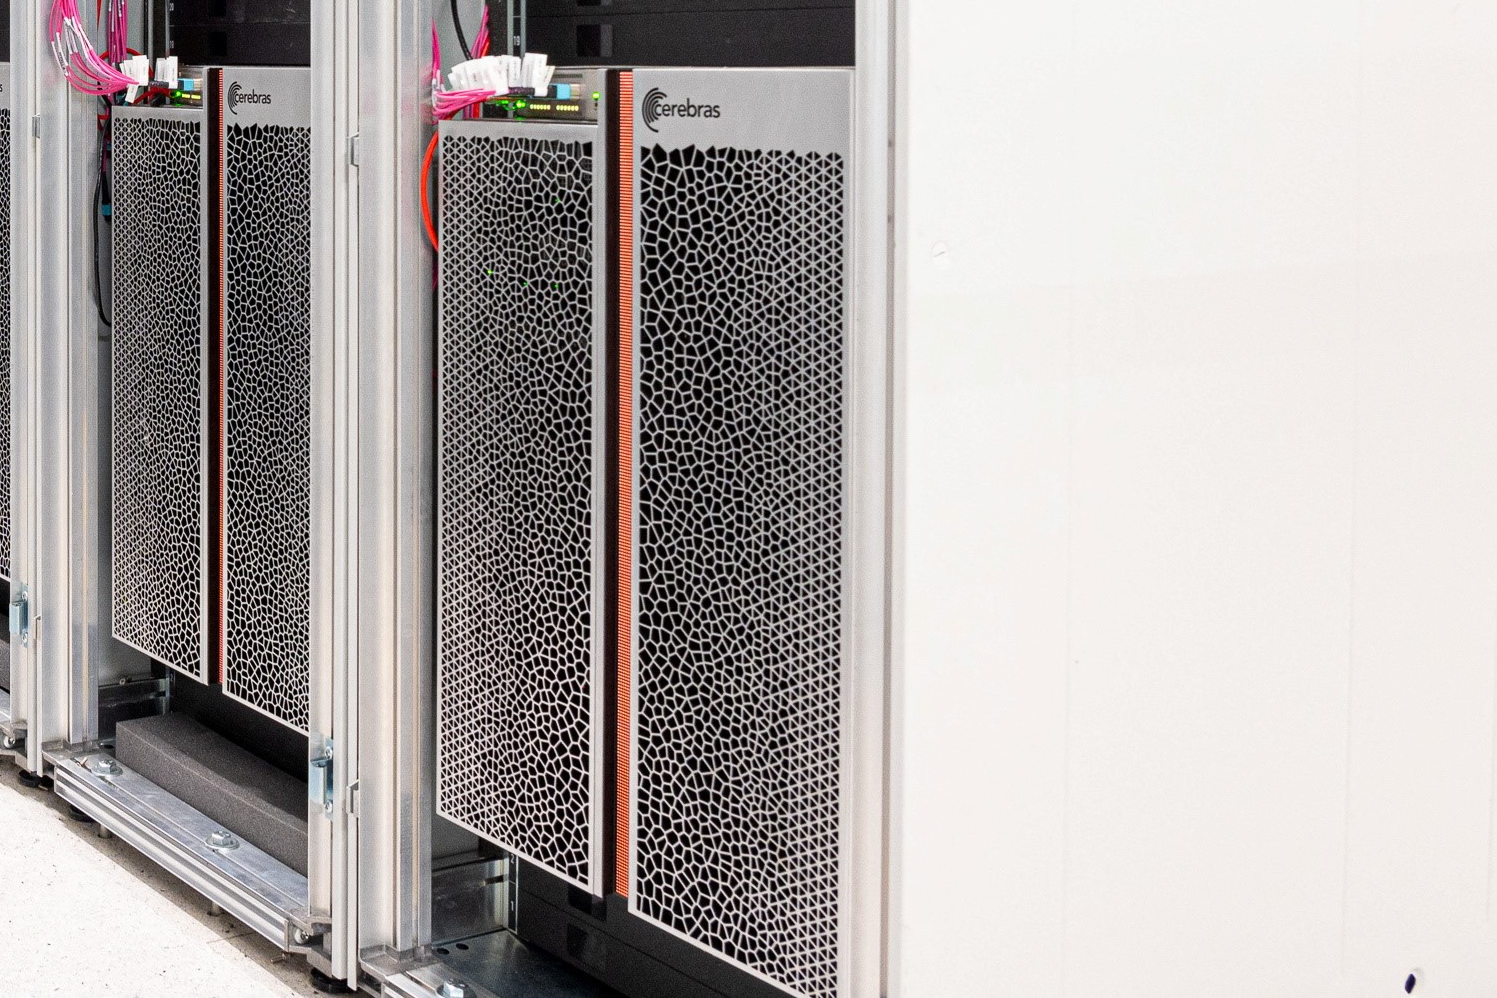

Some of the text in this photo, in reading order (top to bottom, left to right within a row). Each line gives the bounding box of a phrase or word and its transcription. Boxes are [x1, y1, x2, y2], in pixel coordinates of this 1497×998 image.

[513, 35, 521, 46] 19
[234, 88, 272, 105] cerebras
[654, 97, 721, 119] cerebras
